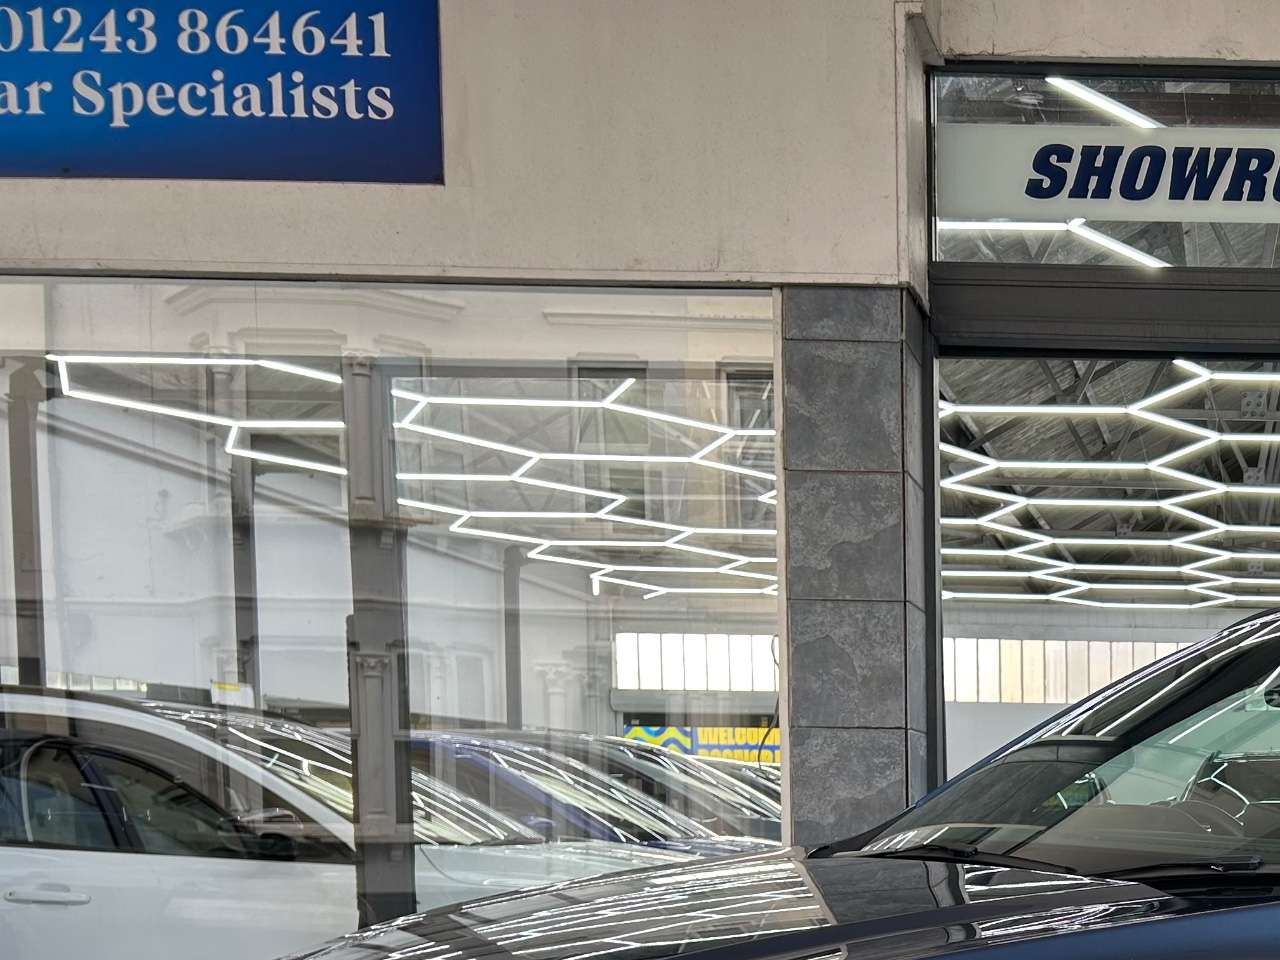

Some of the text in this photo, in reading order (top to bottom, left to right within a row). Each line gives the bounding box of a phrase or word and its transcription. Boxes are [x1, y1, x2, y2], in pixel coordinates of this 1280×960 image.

[0, 6, 391, 57] 01243 864641
[72, 69, 394, 128] Specialists
